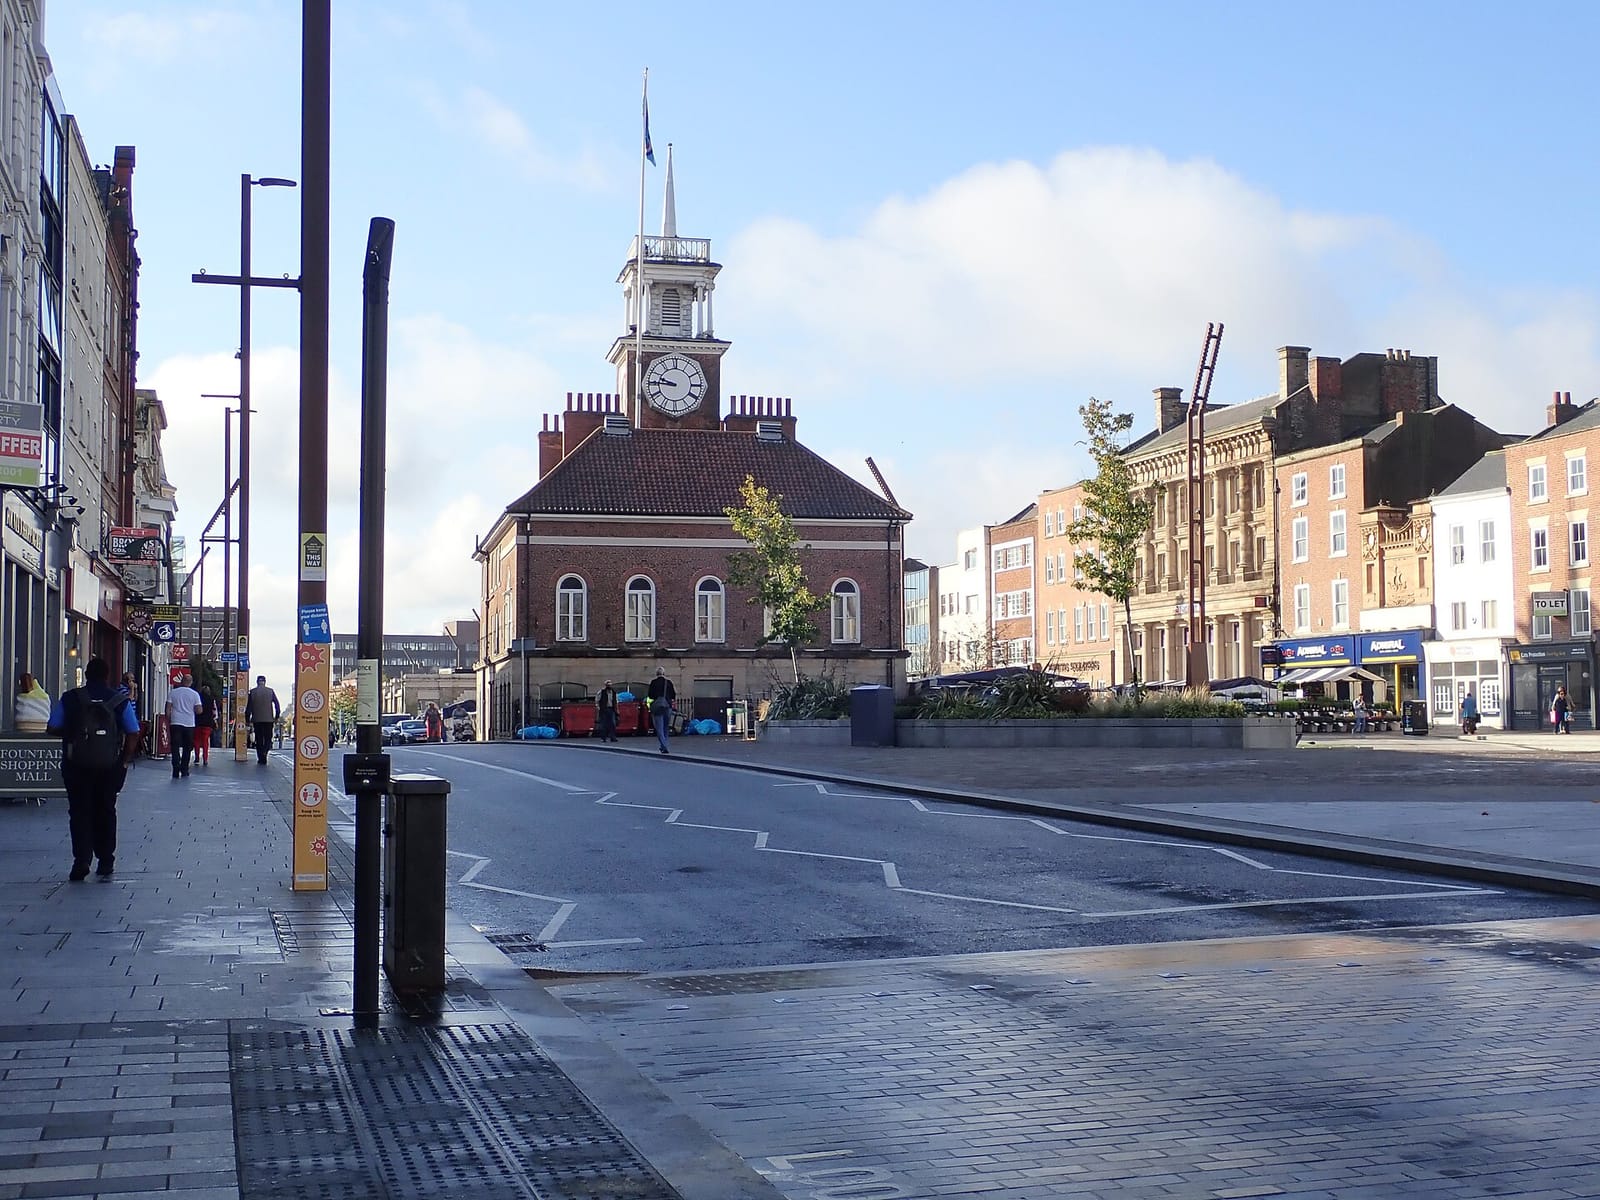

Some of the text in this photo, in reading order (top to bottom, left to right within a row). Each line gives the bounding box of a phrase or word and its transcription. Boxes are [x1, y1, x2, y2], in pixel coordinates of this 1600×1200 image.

[0, 436, 41, 456] FFER
[112, 537, 155, 549] BRONS
[1535, 600, 1565, 608] TO LET
[131, 610, 147, 618] COSTA
[15, 772, 52, 781] MALL
